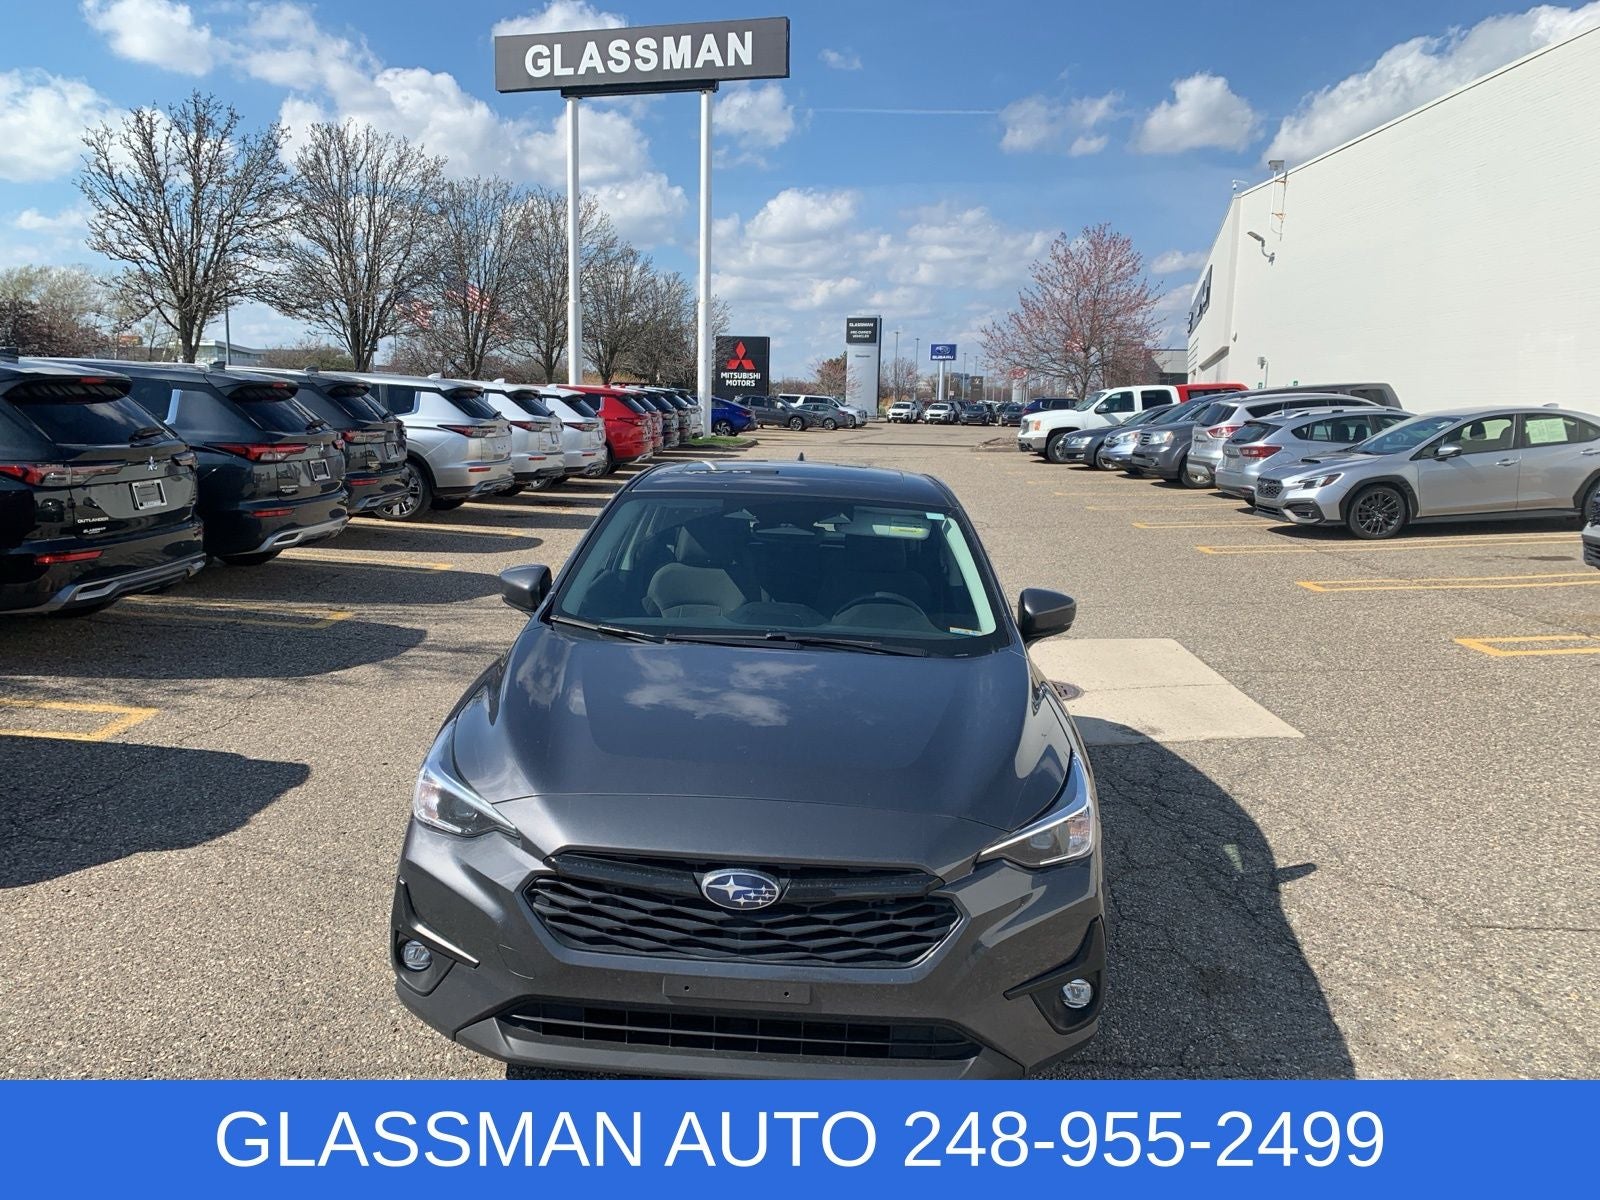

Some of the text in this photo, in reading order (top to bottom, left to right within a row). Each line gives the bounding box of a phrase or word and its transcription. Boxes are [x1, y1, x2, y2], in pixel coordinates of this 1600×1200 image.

[524, 31, 753, 78] GLASSMAN
[720, 372, 761, 380] MITSUBISHI
[725, 379, 756, 387] MOTORS
[77, 516, 109, 524] OUTLANDER
